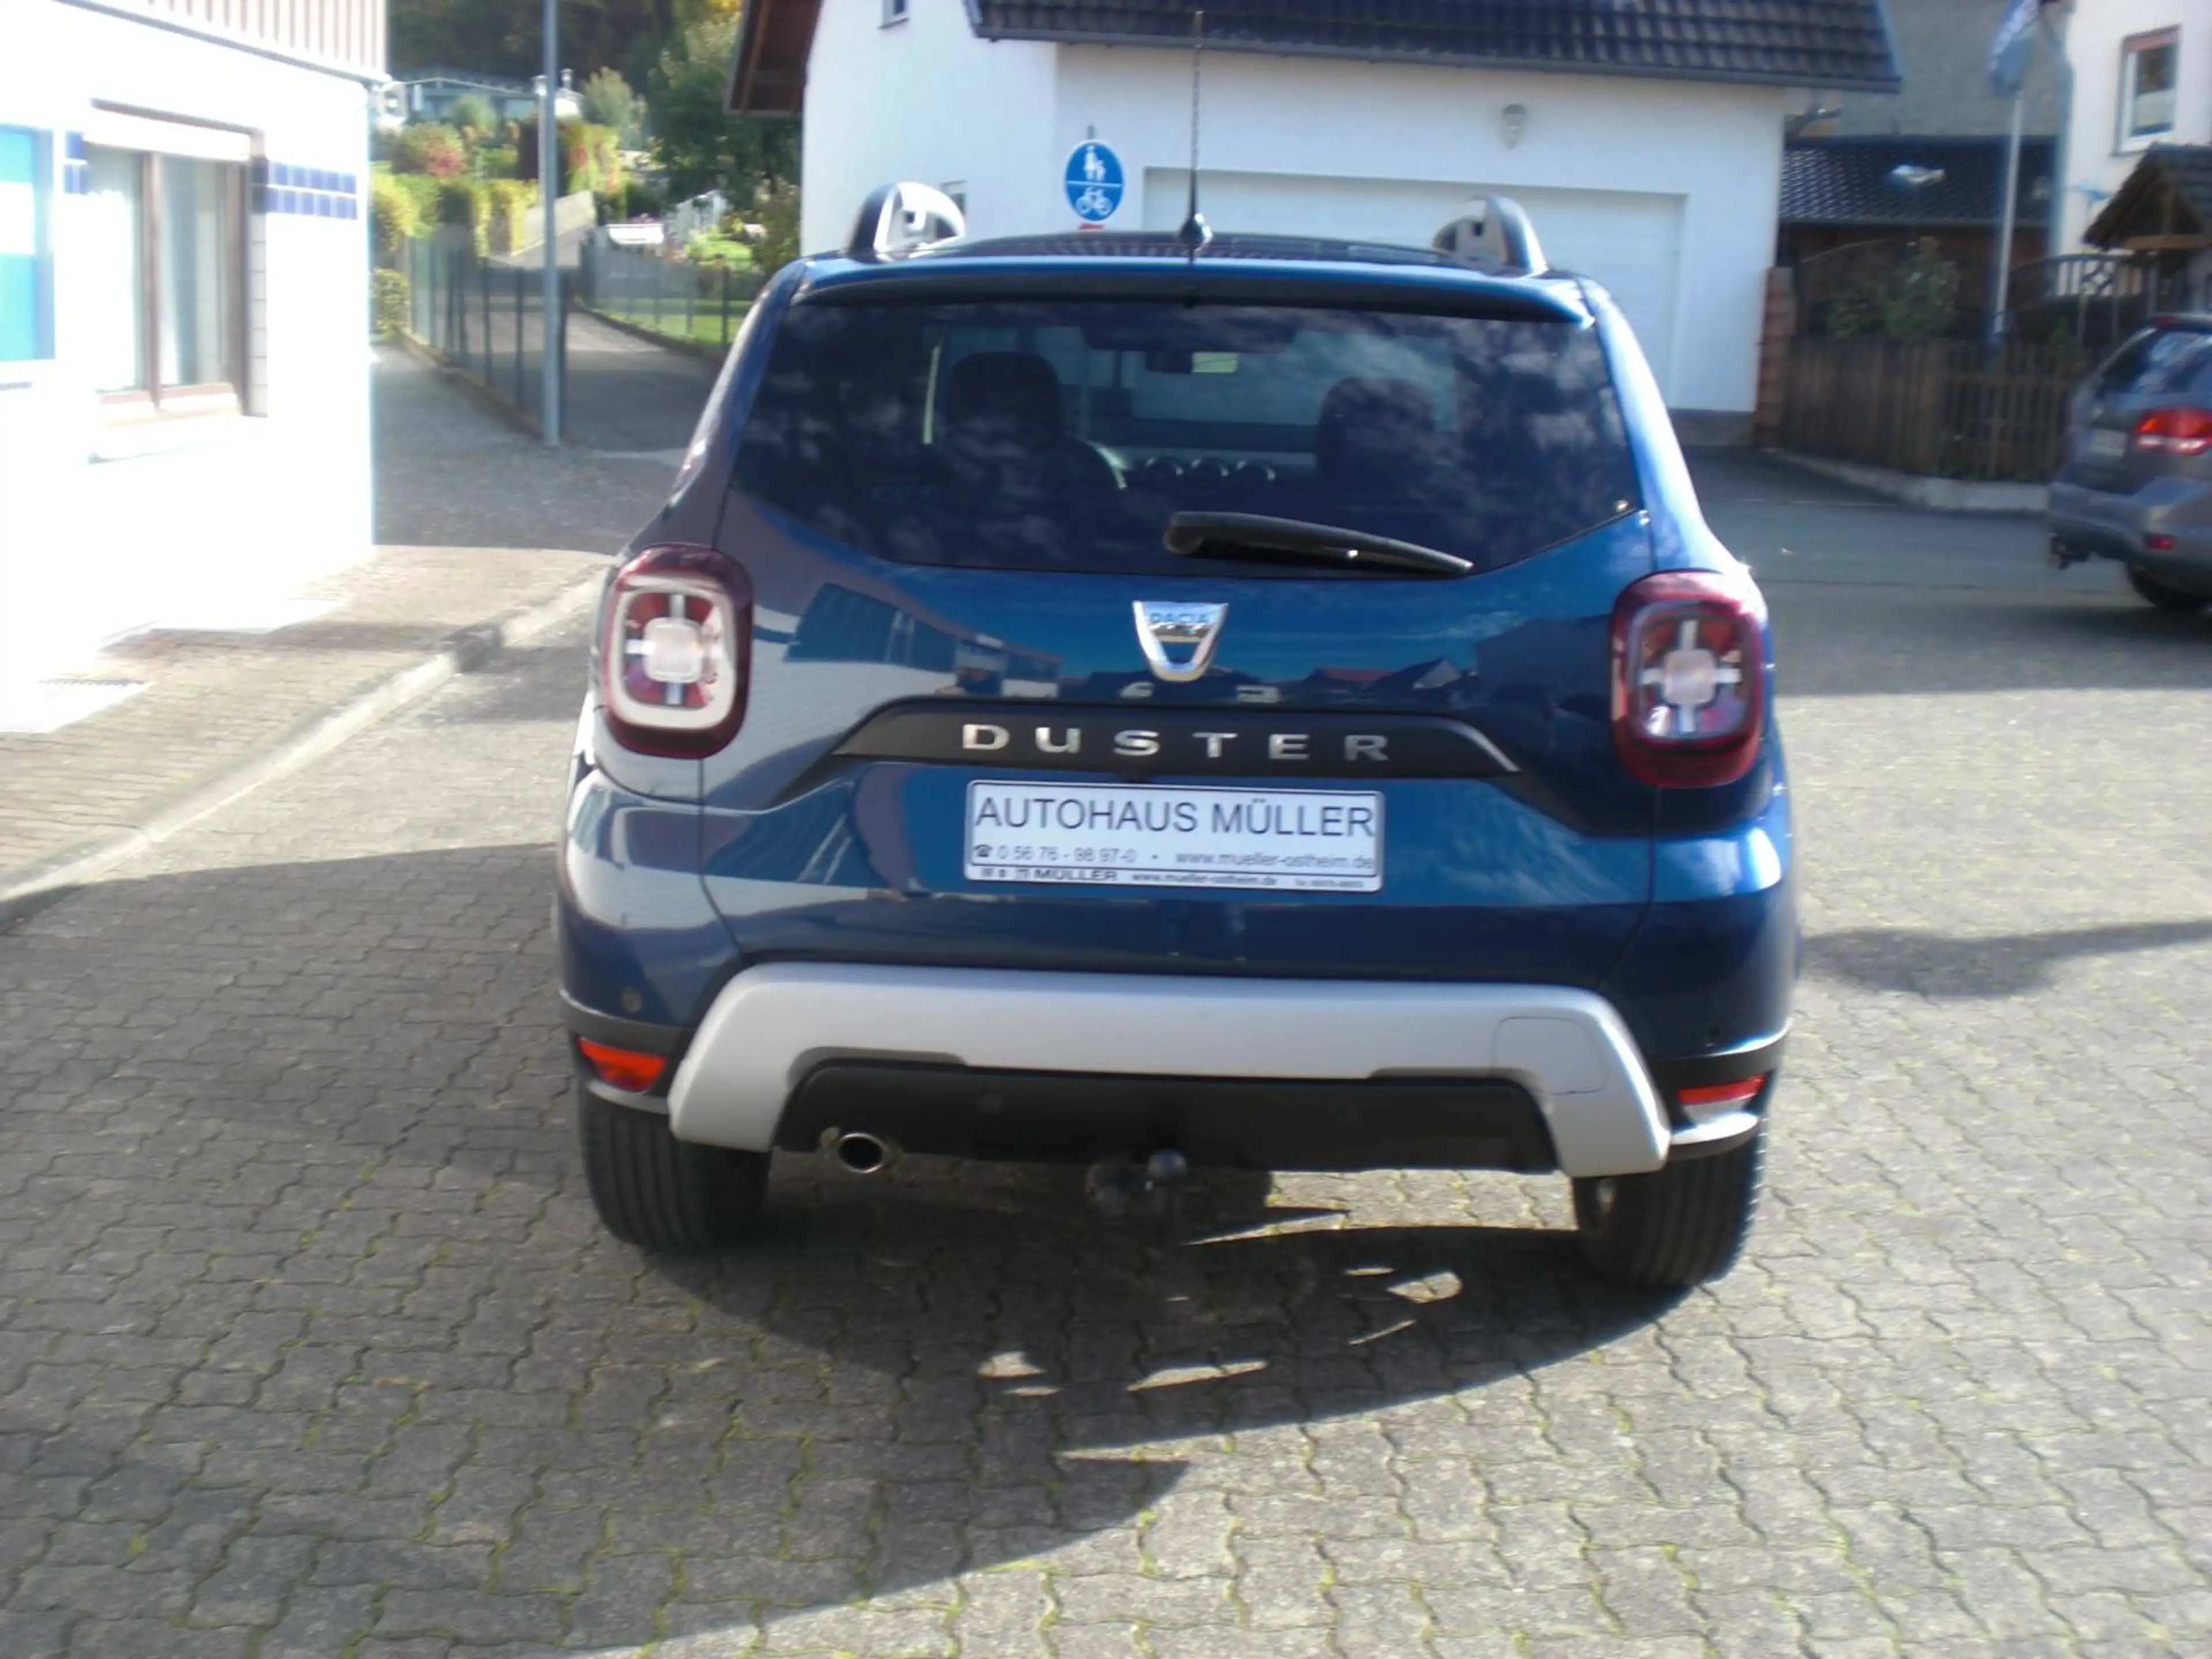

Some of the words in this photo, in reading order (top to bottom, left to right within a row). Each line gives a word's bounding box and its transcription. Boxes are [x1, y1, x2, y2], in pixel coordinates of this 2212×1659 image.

[962, 724, 1388, 761] DUSTER
[975, 797, 1198, 832] AUTOHAUS
[1211, 798, 1375, 837] MÜLLER
[997, 845, 1009, 860] 0
